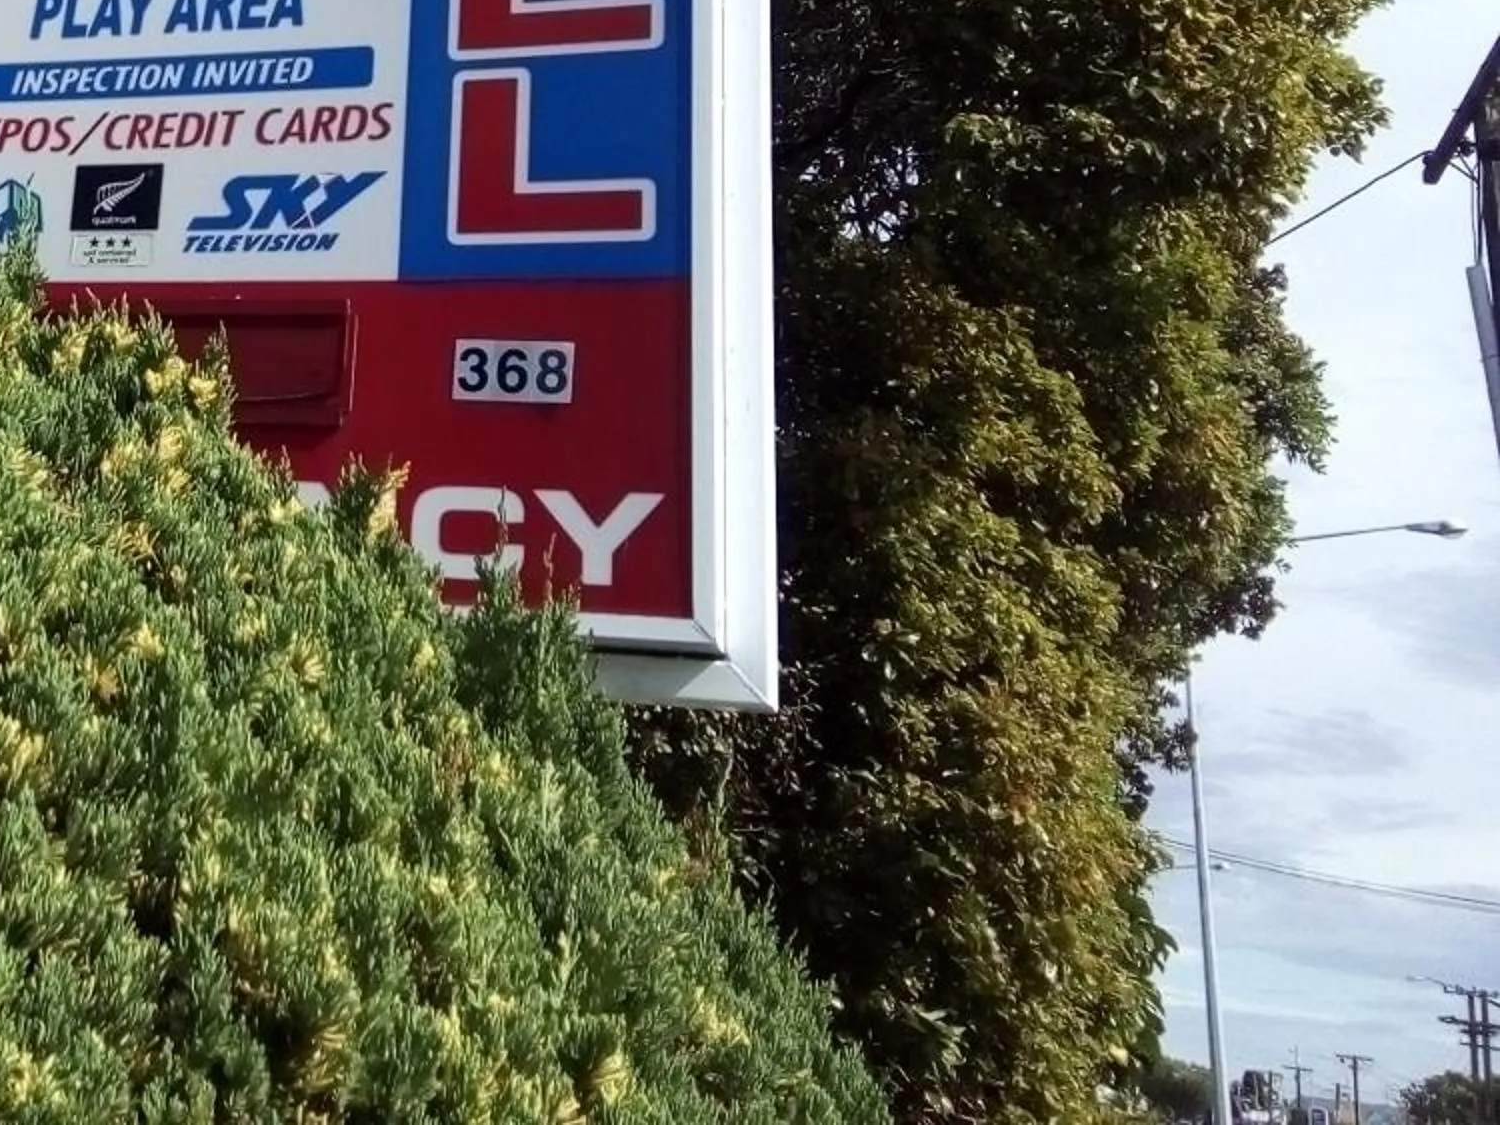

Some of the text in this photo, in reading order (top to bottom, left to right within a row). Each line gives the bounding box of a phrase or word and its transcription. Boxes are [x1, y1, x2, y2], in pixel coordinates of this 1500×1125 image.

[11, 56, 314, 96] INSPECTION INVITED
[254, 102, 395, 145] CARDS
[186, 171, 389, 231] SKY
[182, 233, 341, 253] TELEVISION
[457, 347, 569, 394] 368
[298, 481, 665, 586] CY
